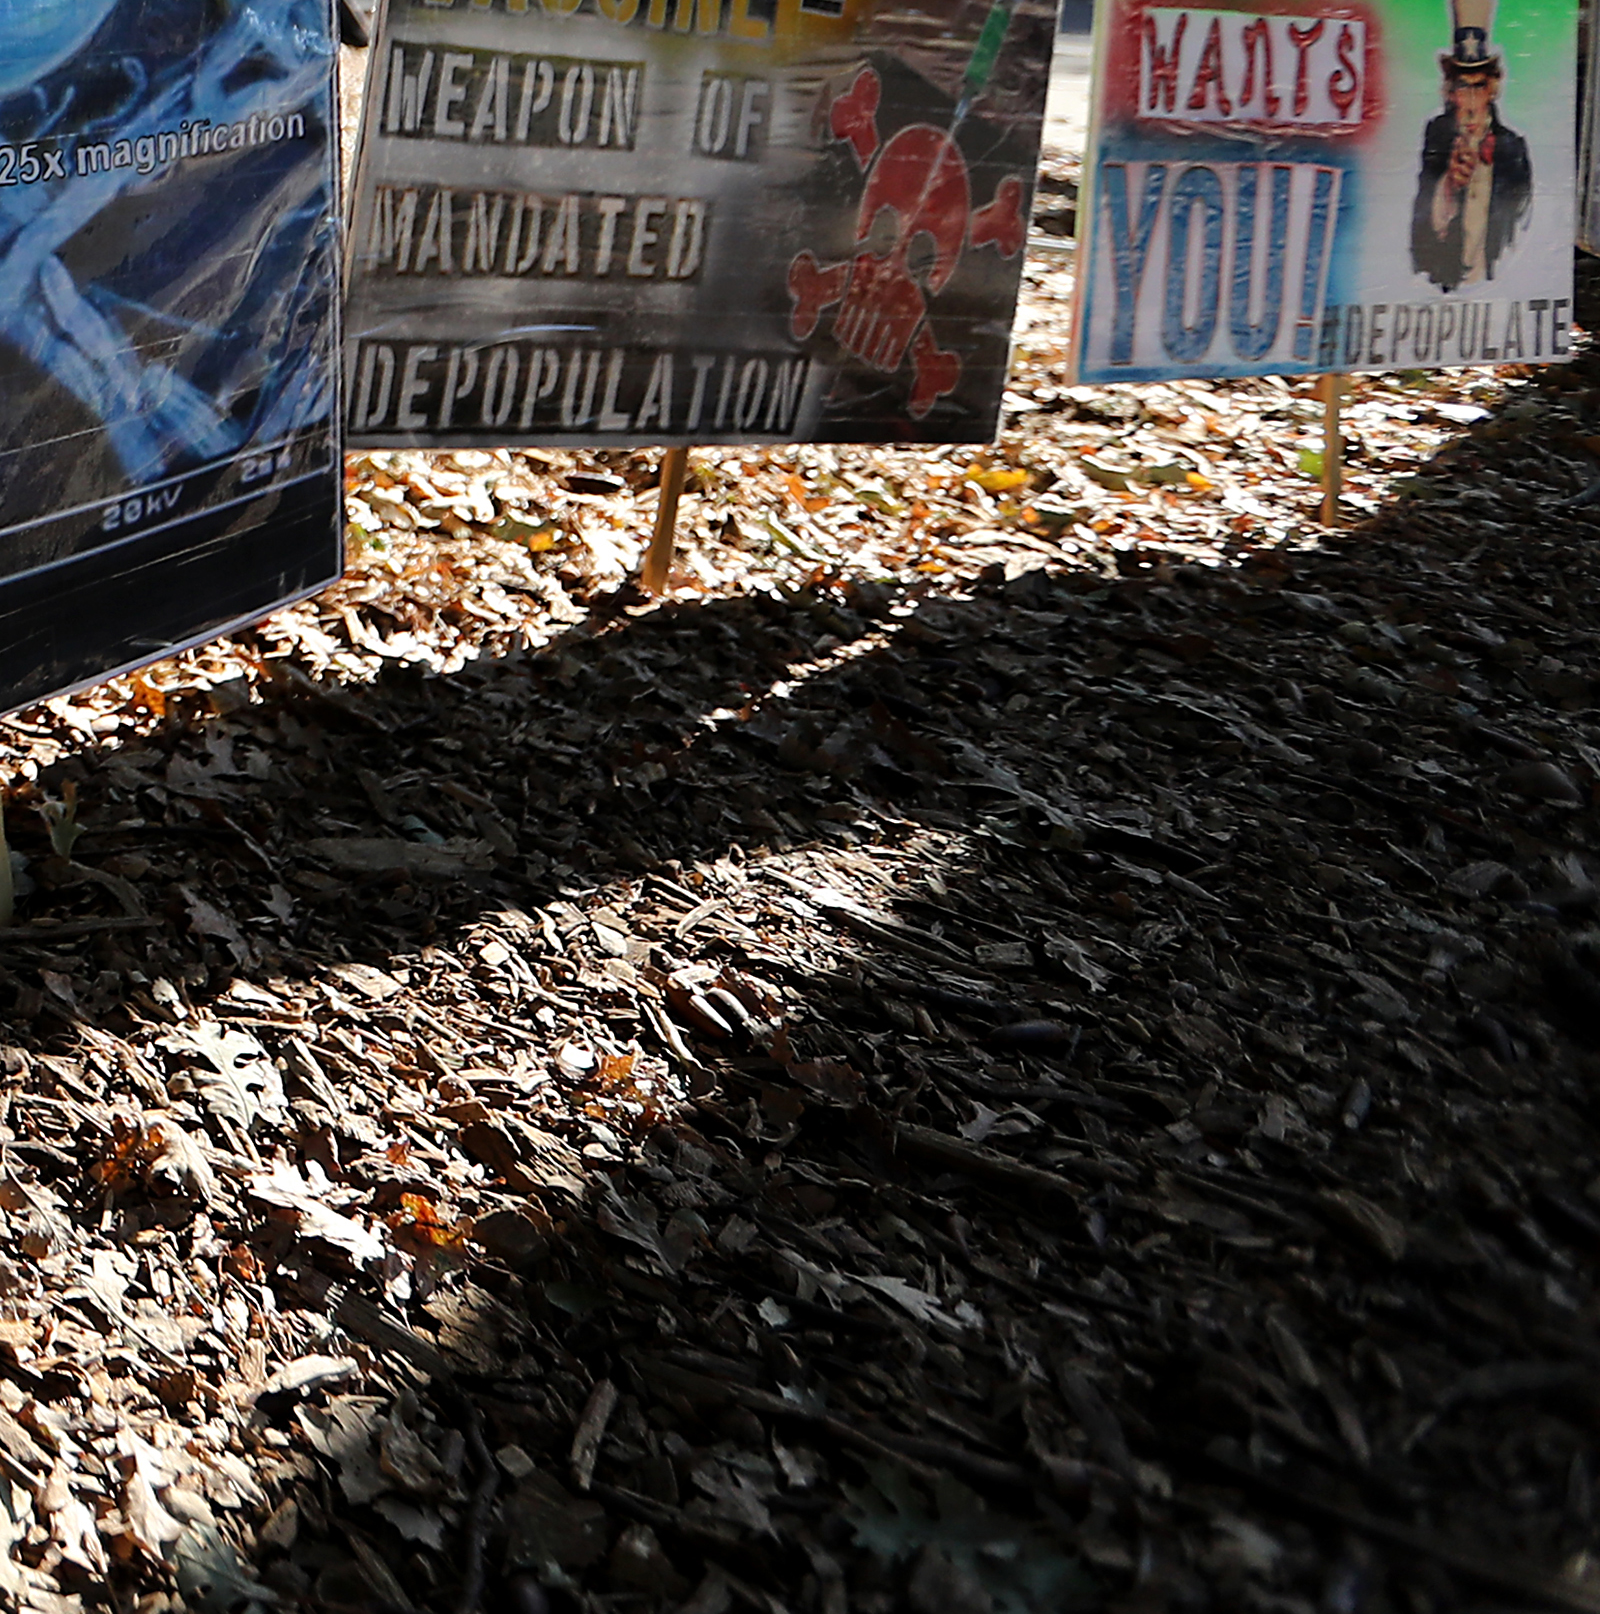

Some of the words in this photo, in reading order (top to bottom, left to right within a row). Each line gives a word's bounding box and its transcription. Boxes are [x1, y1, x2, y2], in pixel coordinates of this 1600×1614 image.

[76, 112, 306, 178] magnification
[384, 40, 640, 148] WEAPON
[698, 76, 768, 160] OF
[364, 188, 706, 280] MANDATED
[1102, 164, 1338, 365] YOU!
[1318, 298, 1570, 368] #DEPOPULATE
[346, 340, 806, 434] DEPOPULATION
